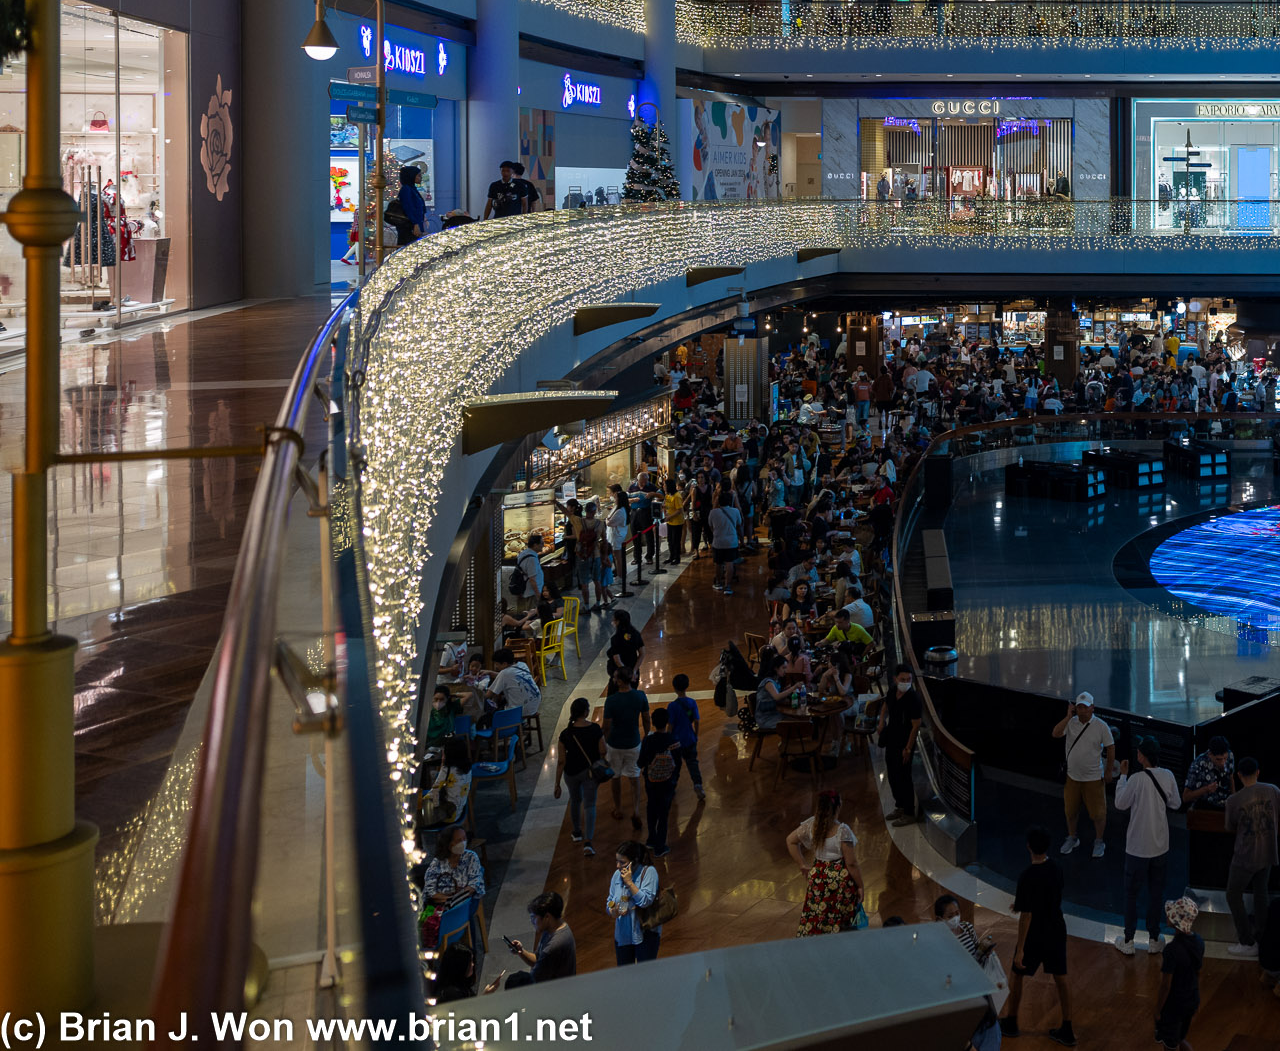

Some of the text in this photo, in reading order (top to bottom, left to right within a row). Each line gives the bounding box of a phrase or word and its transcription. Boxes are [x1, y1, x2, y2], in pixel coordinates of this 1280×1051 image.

[395, 45, 426, 75] KIDS21
[576, 83, 602, 104] KIDS21
[931, 100, 1000, 115] GUCCI
[1198, 105, 1245, 116] EMPORIO
[712, 150, 747, 165] AIMER KIDS
[714, 169, 730, 178] OPENING
[827, 172, 855, 180] GUCCI
[1079, 173, 1107, 181] GUCCI
